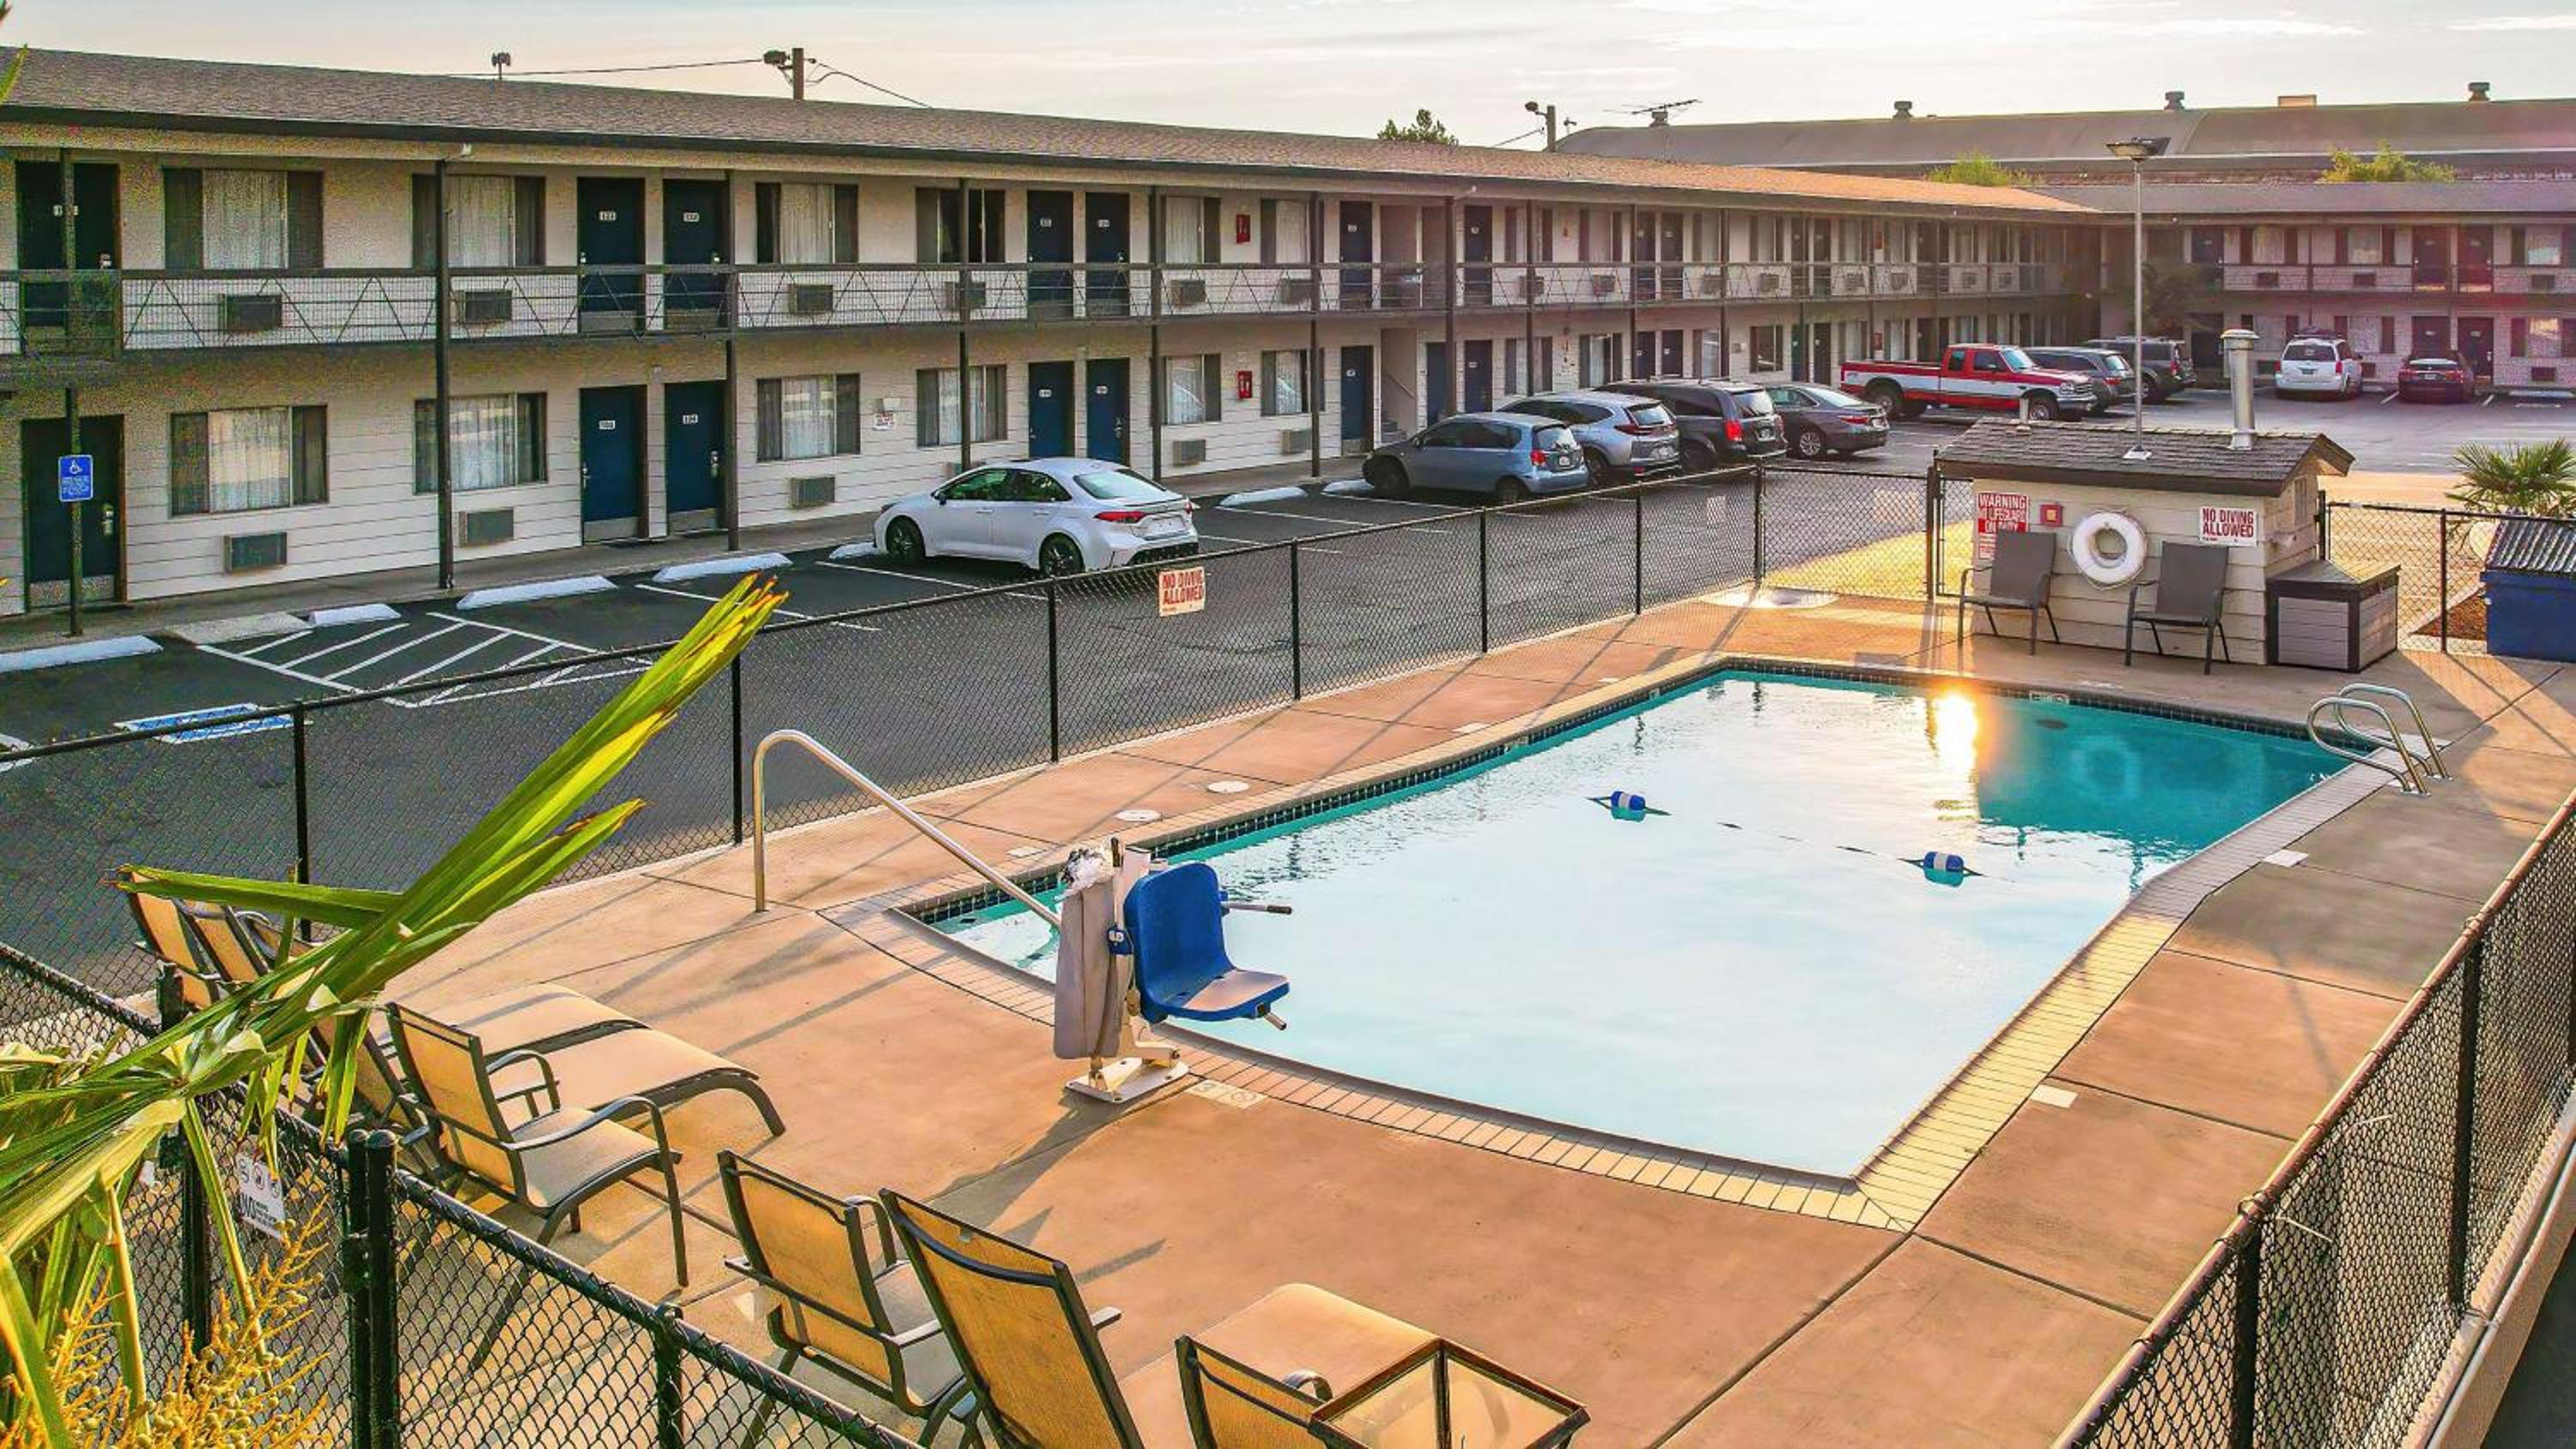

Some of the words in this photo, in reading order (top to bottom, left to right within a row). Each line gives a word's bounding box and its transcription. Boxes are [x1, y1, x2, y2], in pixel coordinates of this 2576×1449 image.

[1978, 494, 2026, 509] WARNING
[2202, 507, 2216, 522] NO
[2220, 509, 2254, 524] DIVING
[2202, 522, 2254, 538] ALLOWED
[1163, 573, 1176, 589] NO
[1178, 569, 1203, 587] DIVING
[1163, 585, 1203, 604] ALLOWED
